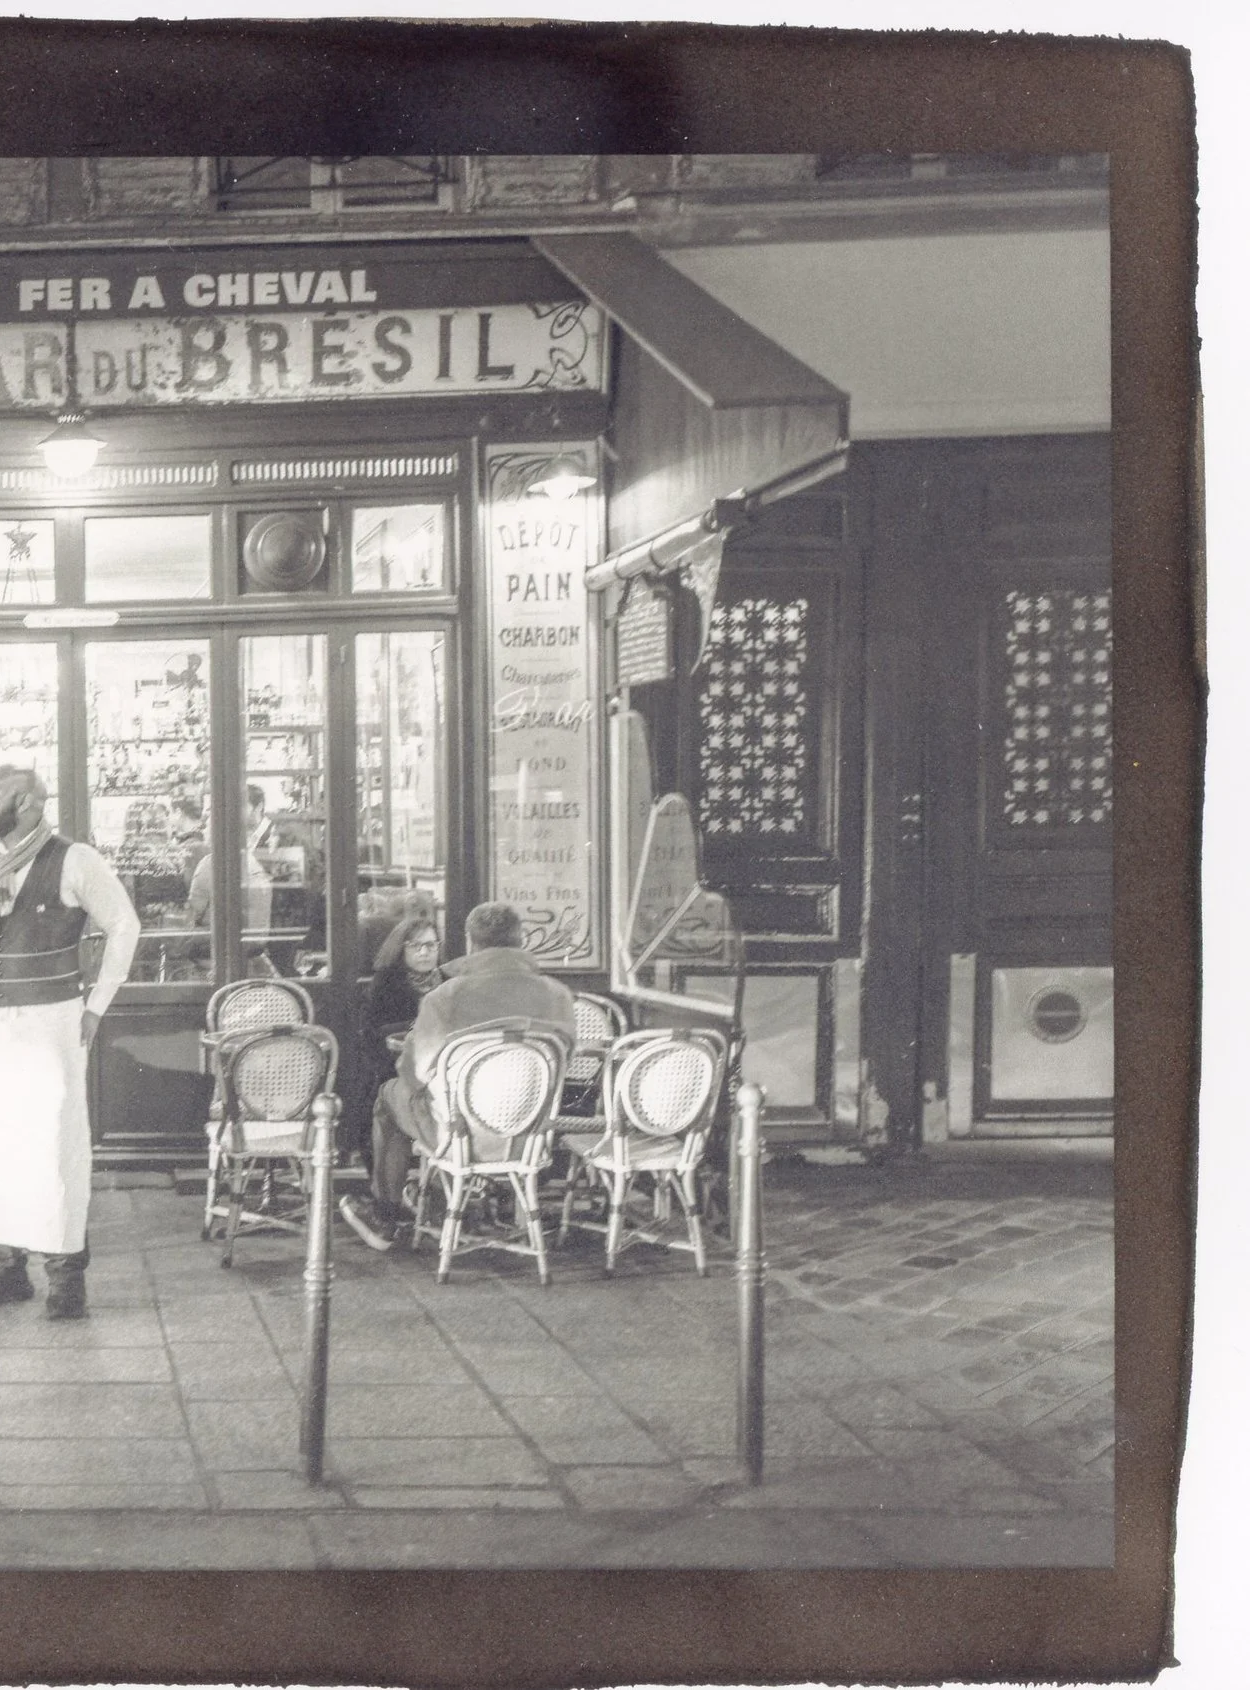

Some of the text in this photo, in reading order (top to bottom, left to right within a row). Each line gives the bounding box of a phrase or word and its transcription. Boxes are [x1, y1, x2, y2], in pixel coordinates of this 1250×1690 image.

[19, 278, 112, 312] FER
[128, 275, 166, 309] A
[183, 270, 378, 309] CHEVAL
[92, 344, 150, 395] DU
[507, 573, 572, 602] PAIN
[499, 626, 581, 649] CHARBON
[502, 885, 582, 902] Vins Fins
